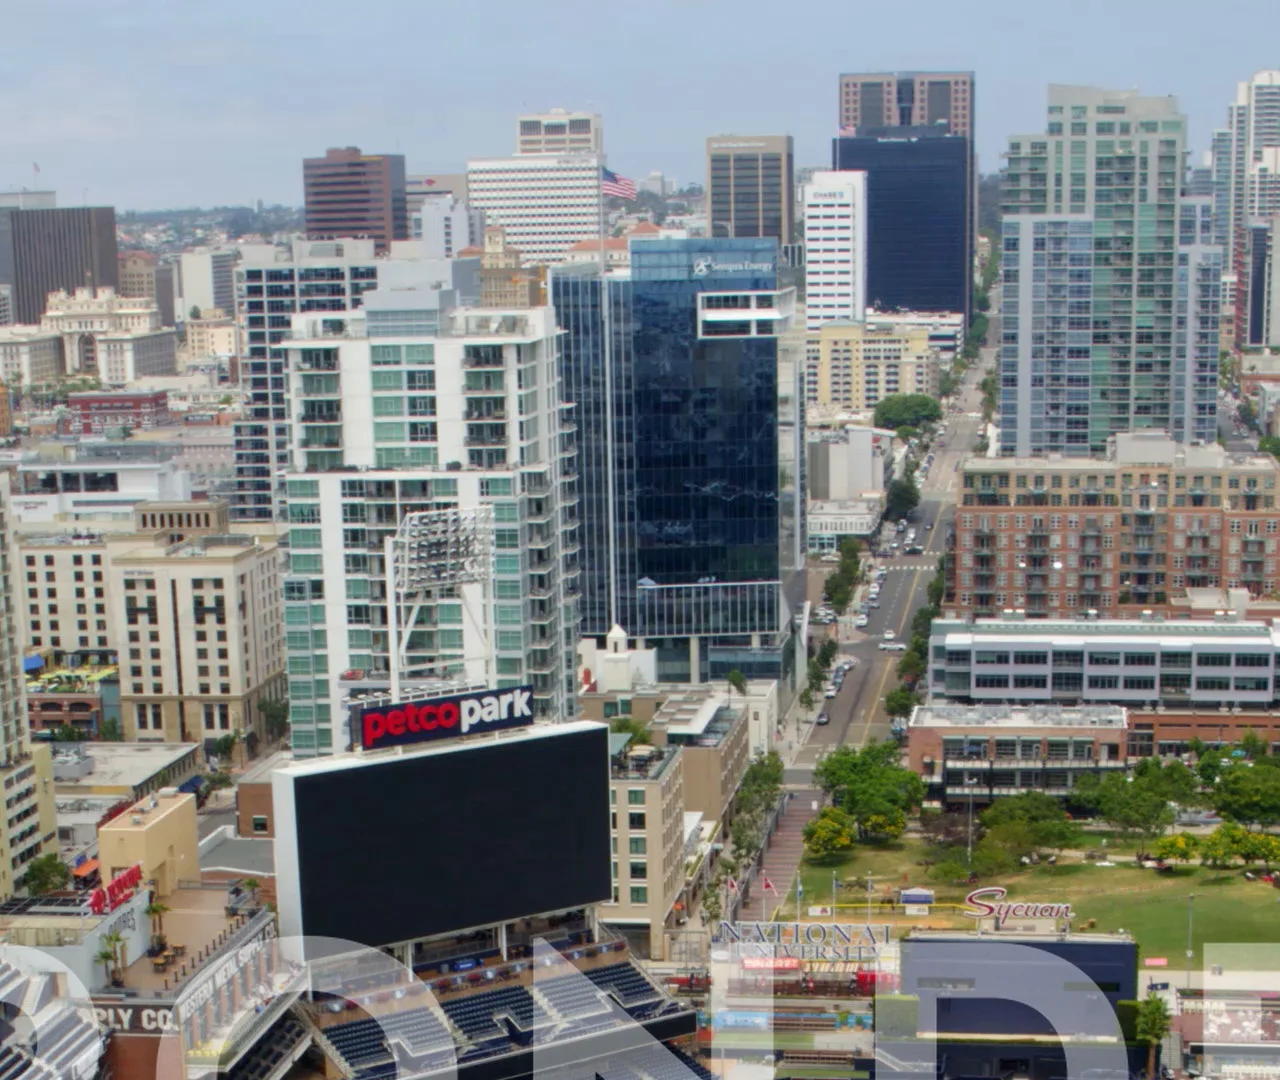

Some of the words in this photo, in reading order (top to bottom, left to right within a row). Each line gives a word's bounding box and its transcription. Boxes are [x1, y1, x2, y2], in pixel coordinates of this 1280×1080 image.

[712, 262, 744, 273] Sempra
[745, 261, 773, 273] Energy
[363, 703, 459, 746] petco
[460, 689, 532, 733] park
[964, 887, 1072, 924] Sycuan
[721, 921, 891, 944] NATIONAL
[736, 943, 883, 961] UNIVERSITY
